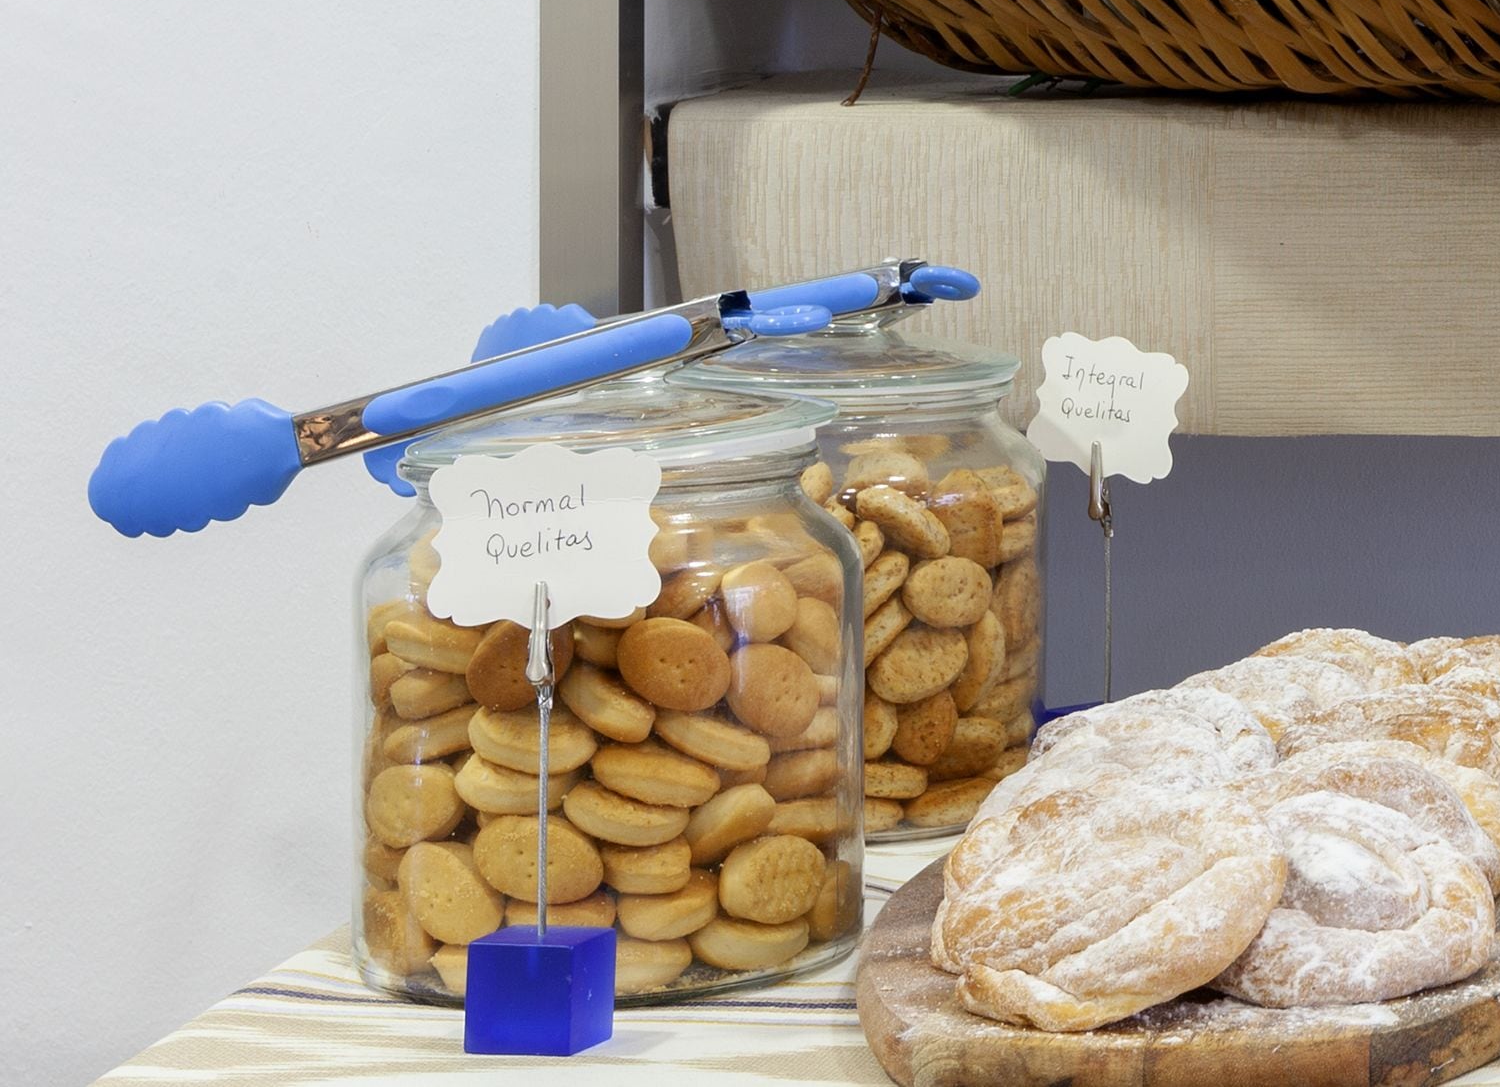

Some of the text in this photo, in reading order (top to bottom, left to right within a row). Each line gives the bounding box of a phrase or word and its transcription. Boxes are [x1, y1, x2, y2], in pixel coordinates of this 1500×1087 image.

[1061, 355, 1145, 399] Integral
[1061, 397, 1132, 423] Quelitas
[486, 528, 593, 564] Quelitas
